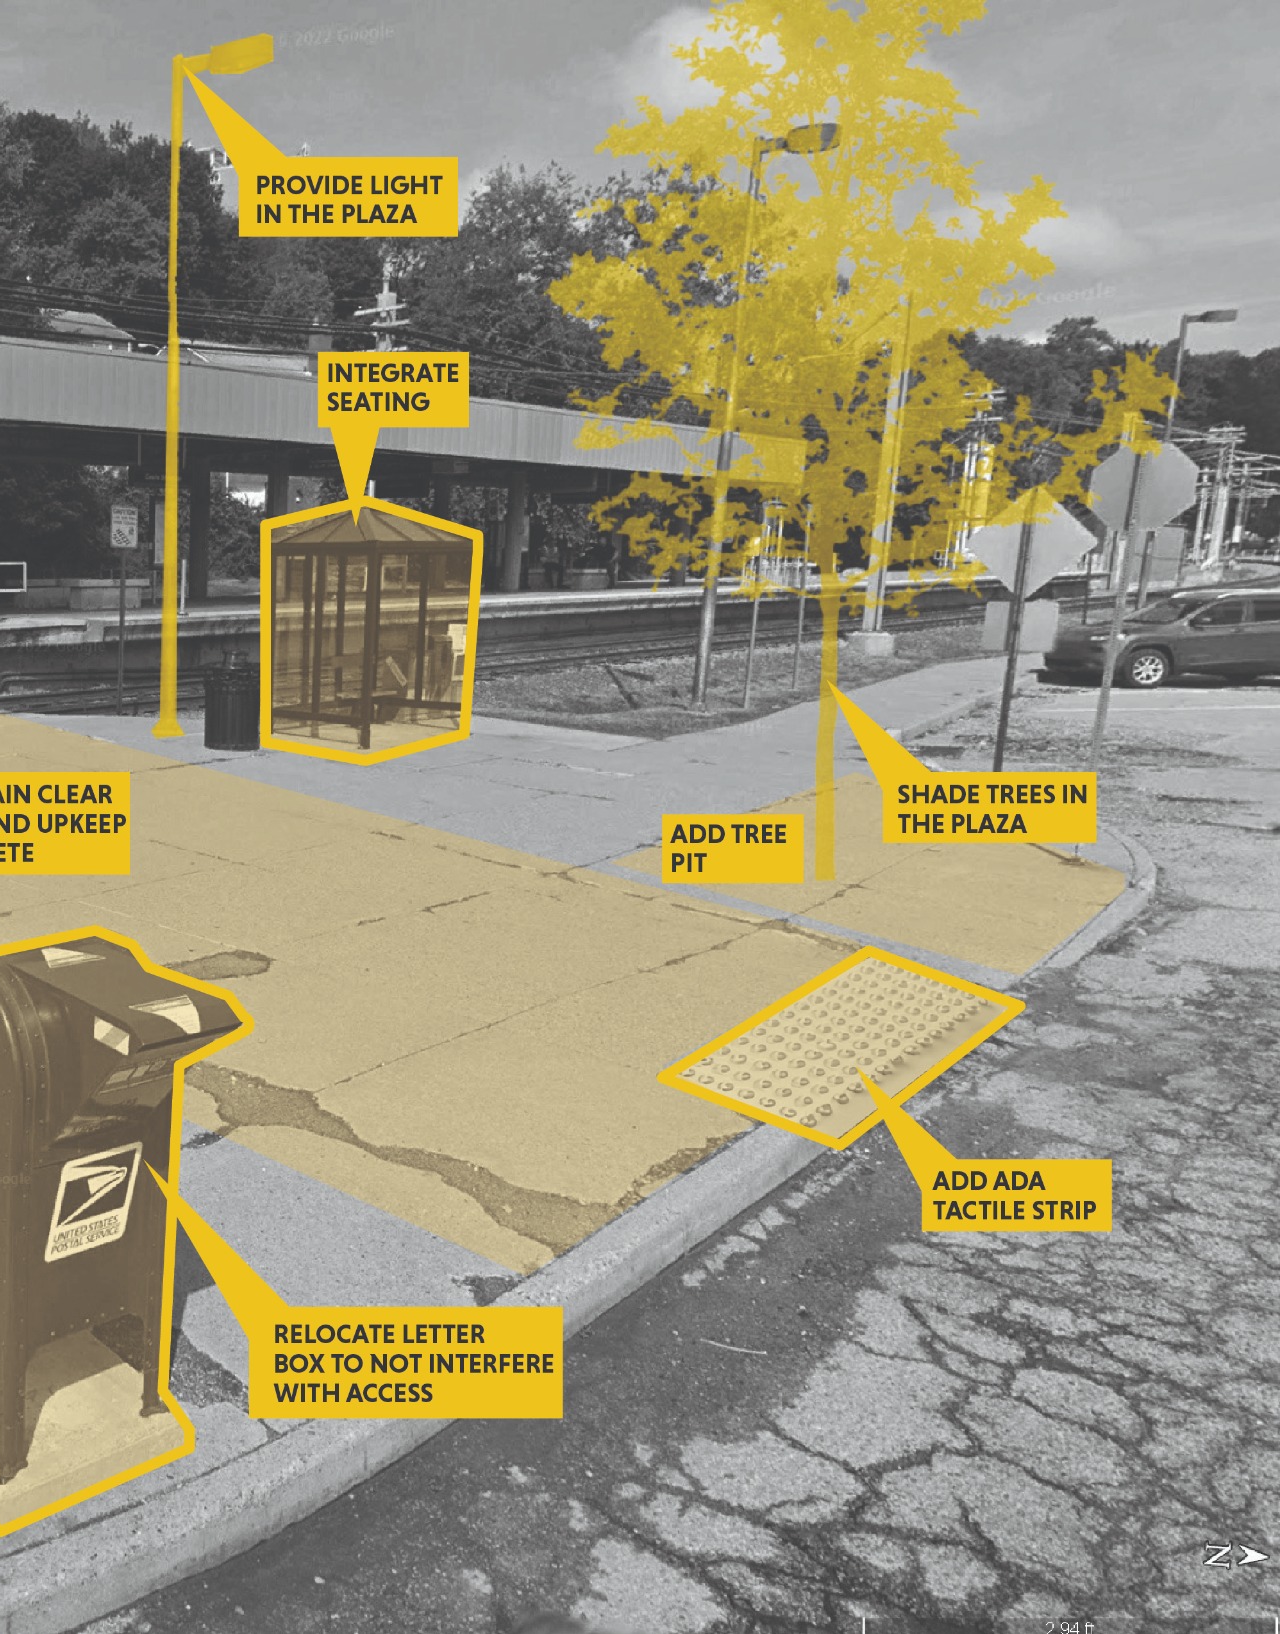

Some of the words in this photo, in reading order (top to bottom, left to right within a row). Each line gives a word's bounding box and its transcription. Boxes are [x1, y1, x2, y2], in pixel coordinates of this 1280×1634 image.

[51, 1238, 84, 1254] POSTAL
[85, 1226, 121, 1243] SERVICE
[53, 1224, 88, 1243] UNITED
[88, 1214, 119, 1230] STATES
